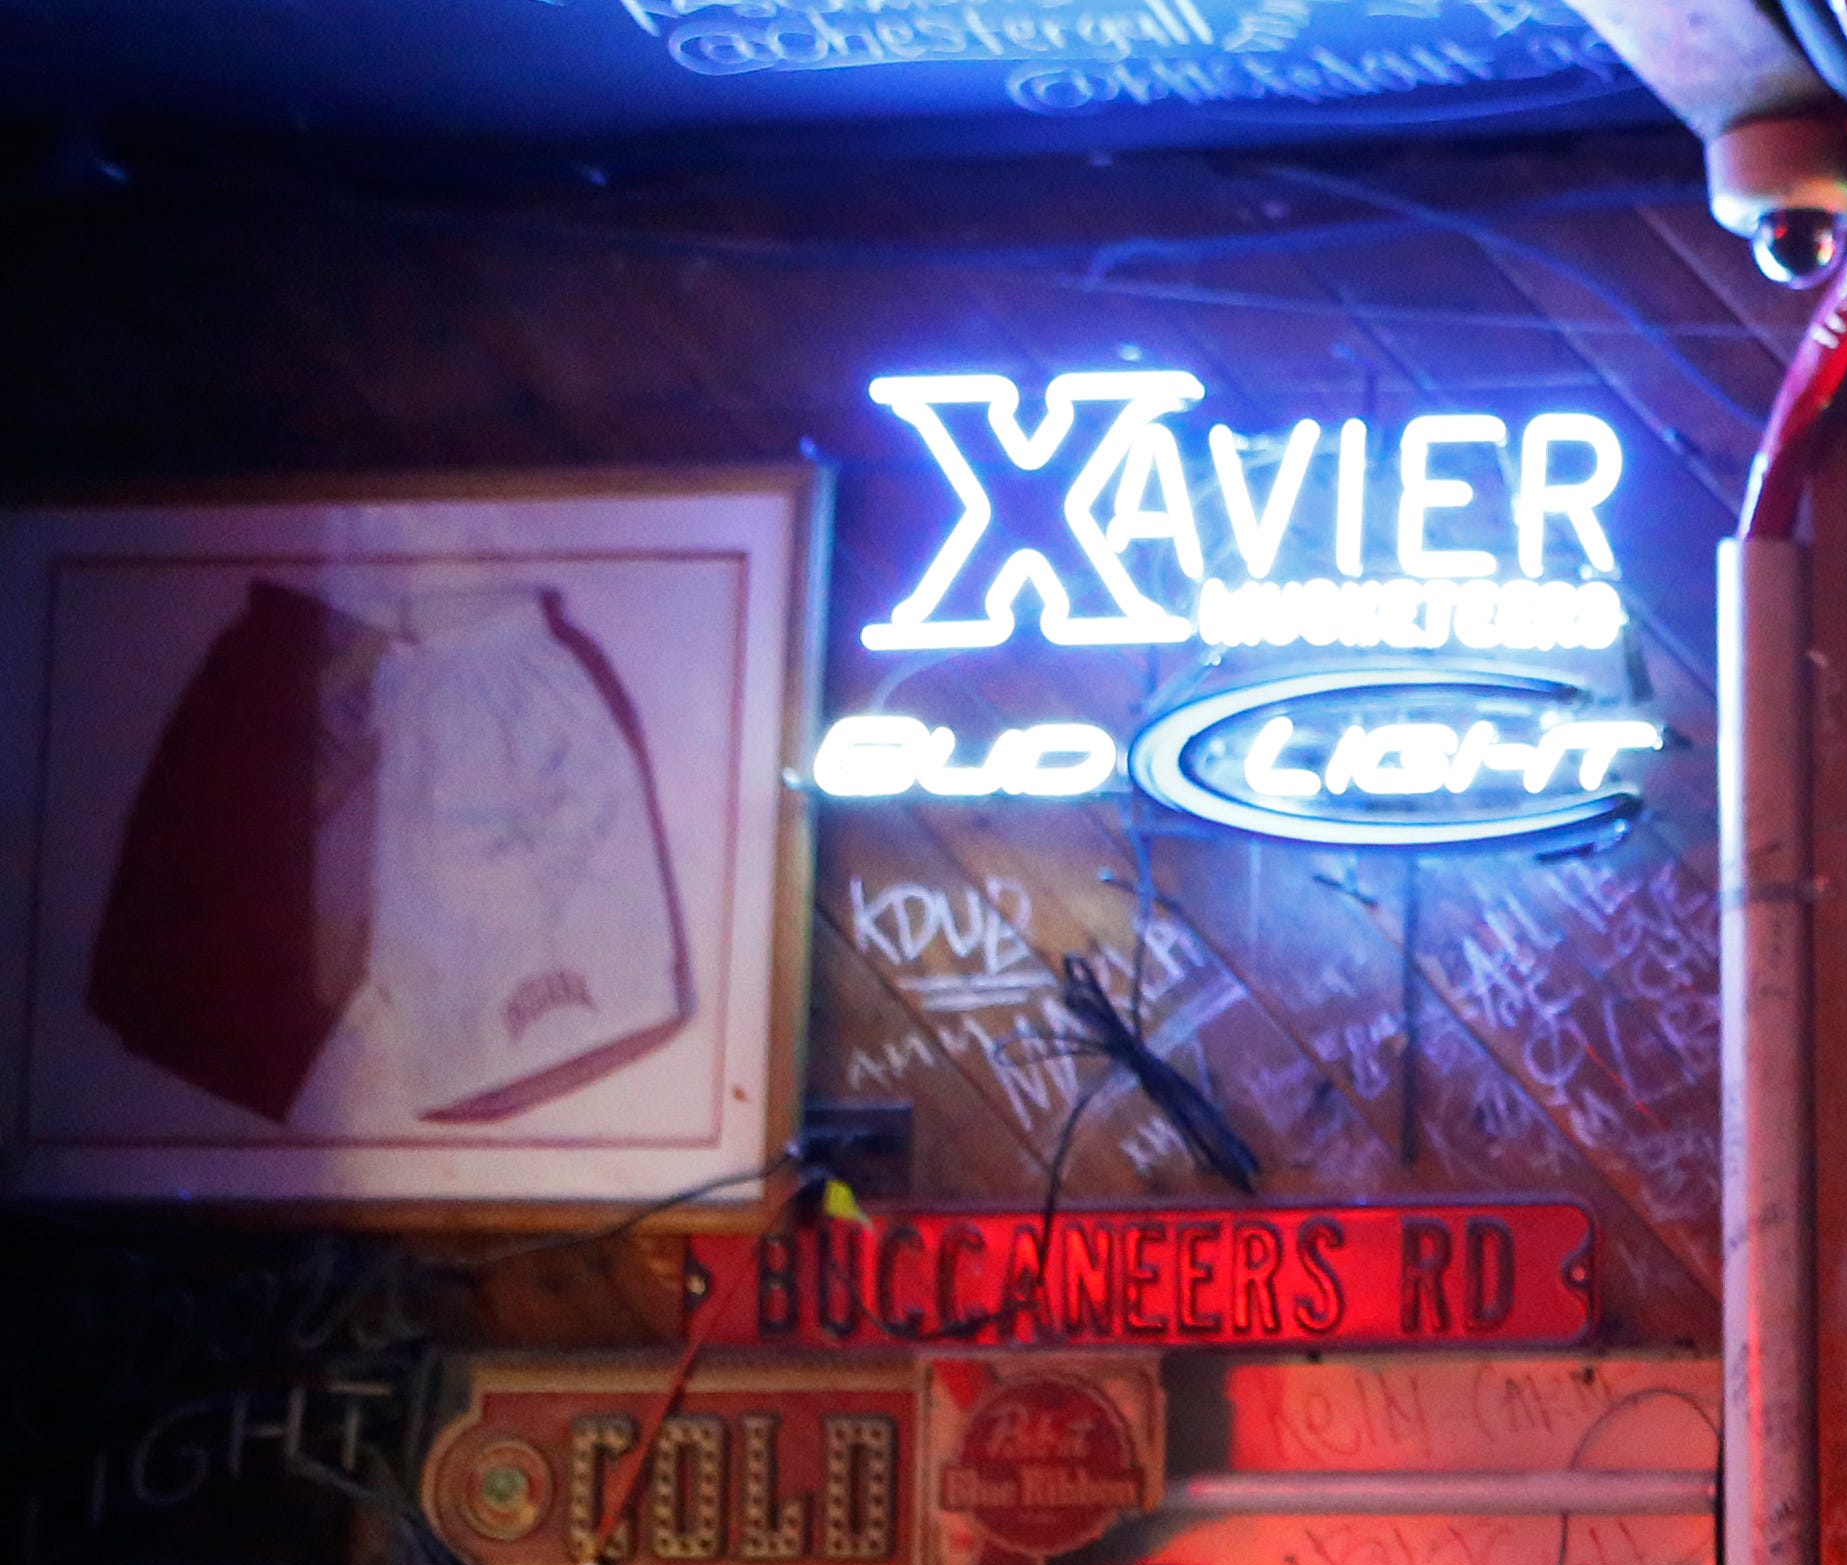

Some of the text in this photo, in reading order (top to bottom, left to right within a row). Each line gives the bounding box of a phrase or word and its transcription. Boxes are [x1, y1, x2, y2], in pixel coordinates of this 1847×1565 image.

[860, 370, 1624, 651] XAVIER
[813, 714, 1664, 797] BUD LIGHT
[755, 1215, 1516, 1343] BUCCANEERS RD
[567, 1410, 900, 1560] COLD
